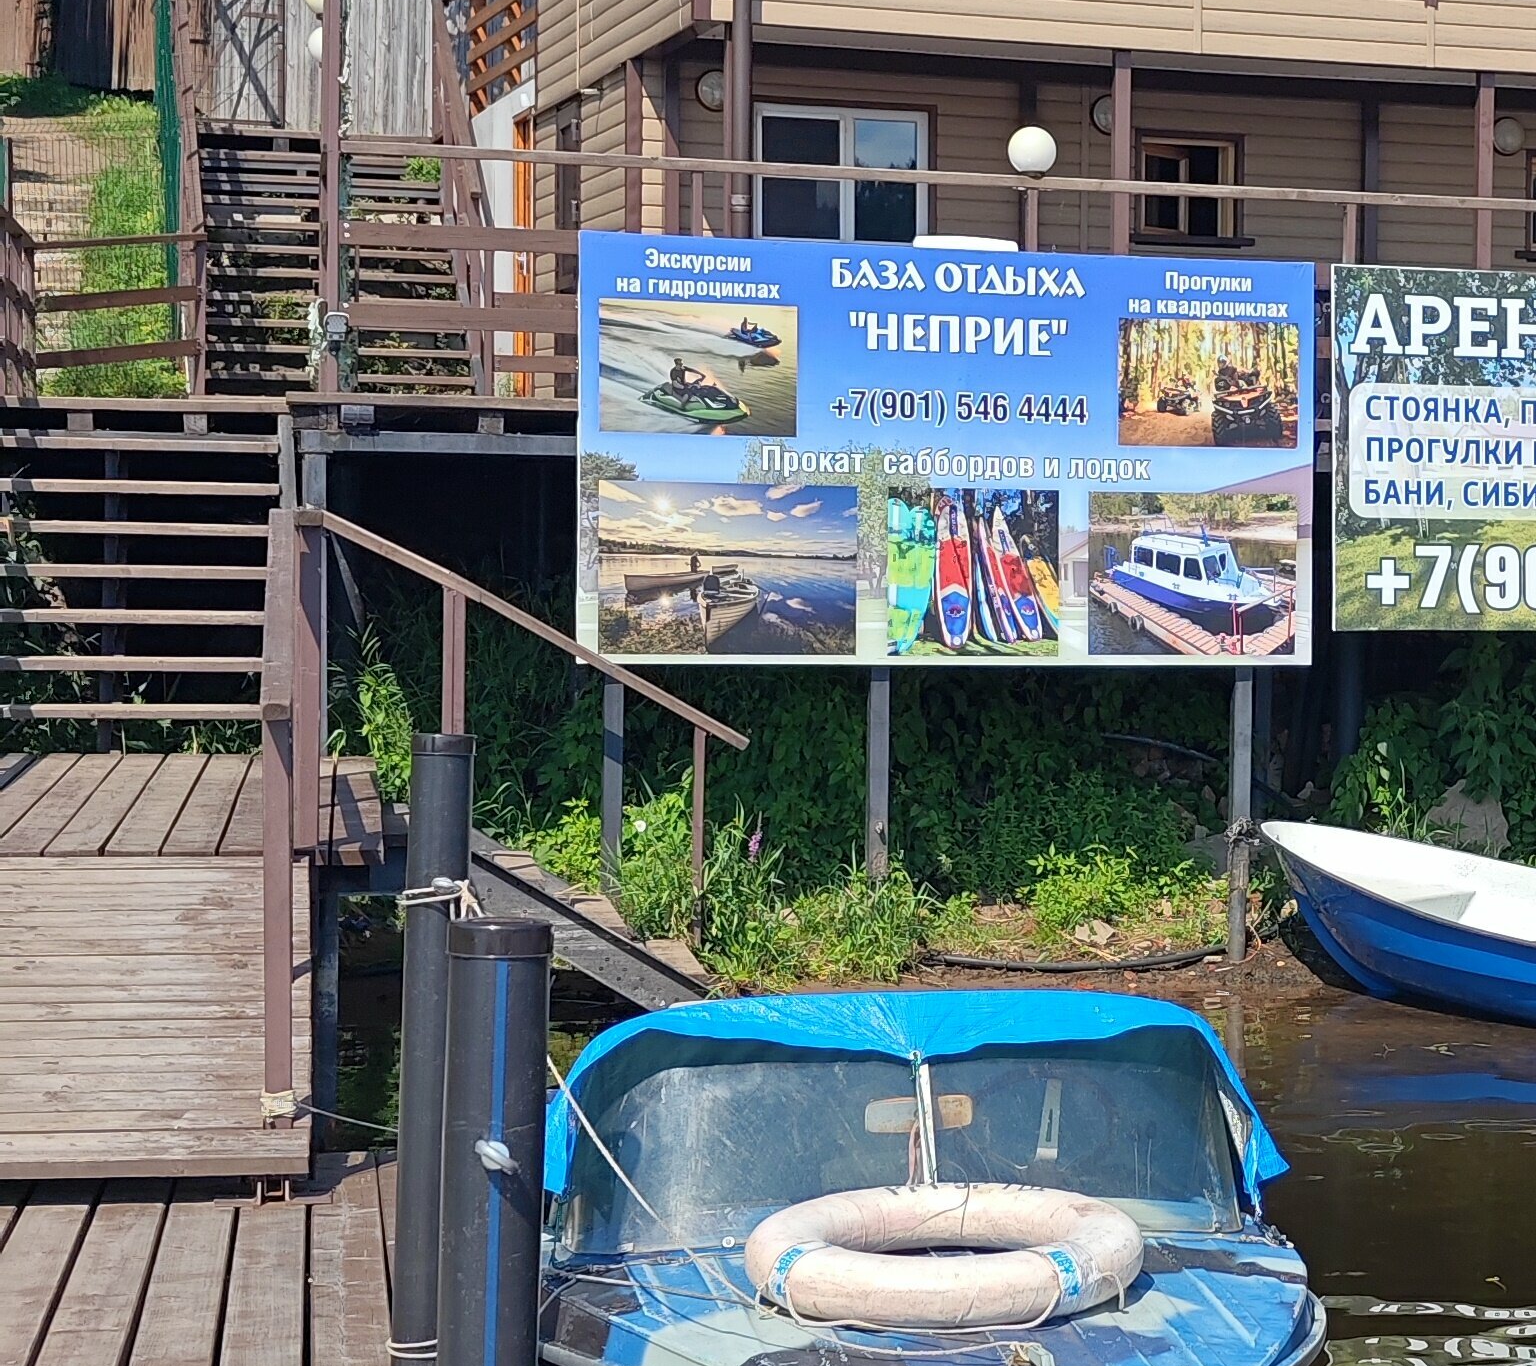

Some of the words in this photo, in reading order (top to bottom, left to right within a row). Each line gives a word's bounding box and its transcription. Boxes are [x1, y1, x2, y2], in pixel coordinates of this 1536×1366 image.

[644, 247, 752, 273] Экскурсии
[616, 277, 641, 293] на
[648, 278, 780, 300] гидроциклах
[831, 258, 926, 292] БАЗА
[935, 261, 1086, 299] ОТДЫХА
[1165, 271, 1252, 295] Прогулки
[1129, 298, 1151, 315] на
[1156, 299, 1288, 318] квадроциклах
[849, 311, 1068, 357] "НЕПРИЕ"
[830, 388, 947, 427] +7(901)
[956, 393, 1009, 423] 546
[1017, 395, 1088, 425] 4444
[1365, 395, 1511, 428] СТОЯНКА,
[761, 444, 865, 477] Прокат
[883, 447, 1035, 482] саббордов
[1043, 457, 1059, 478] и
[1067, 458, 1151, 483] лодок
[1366, 437, 1522, 465] ПРОГУЛКИ
[1364, 479, 1454, 510] БАНИ,
